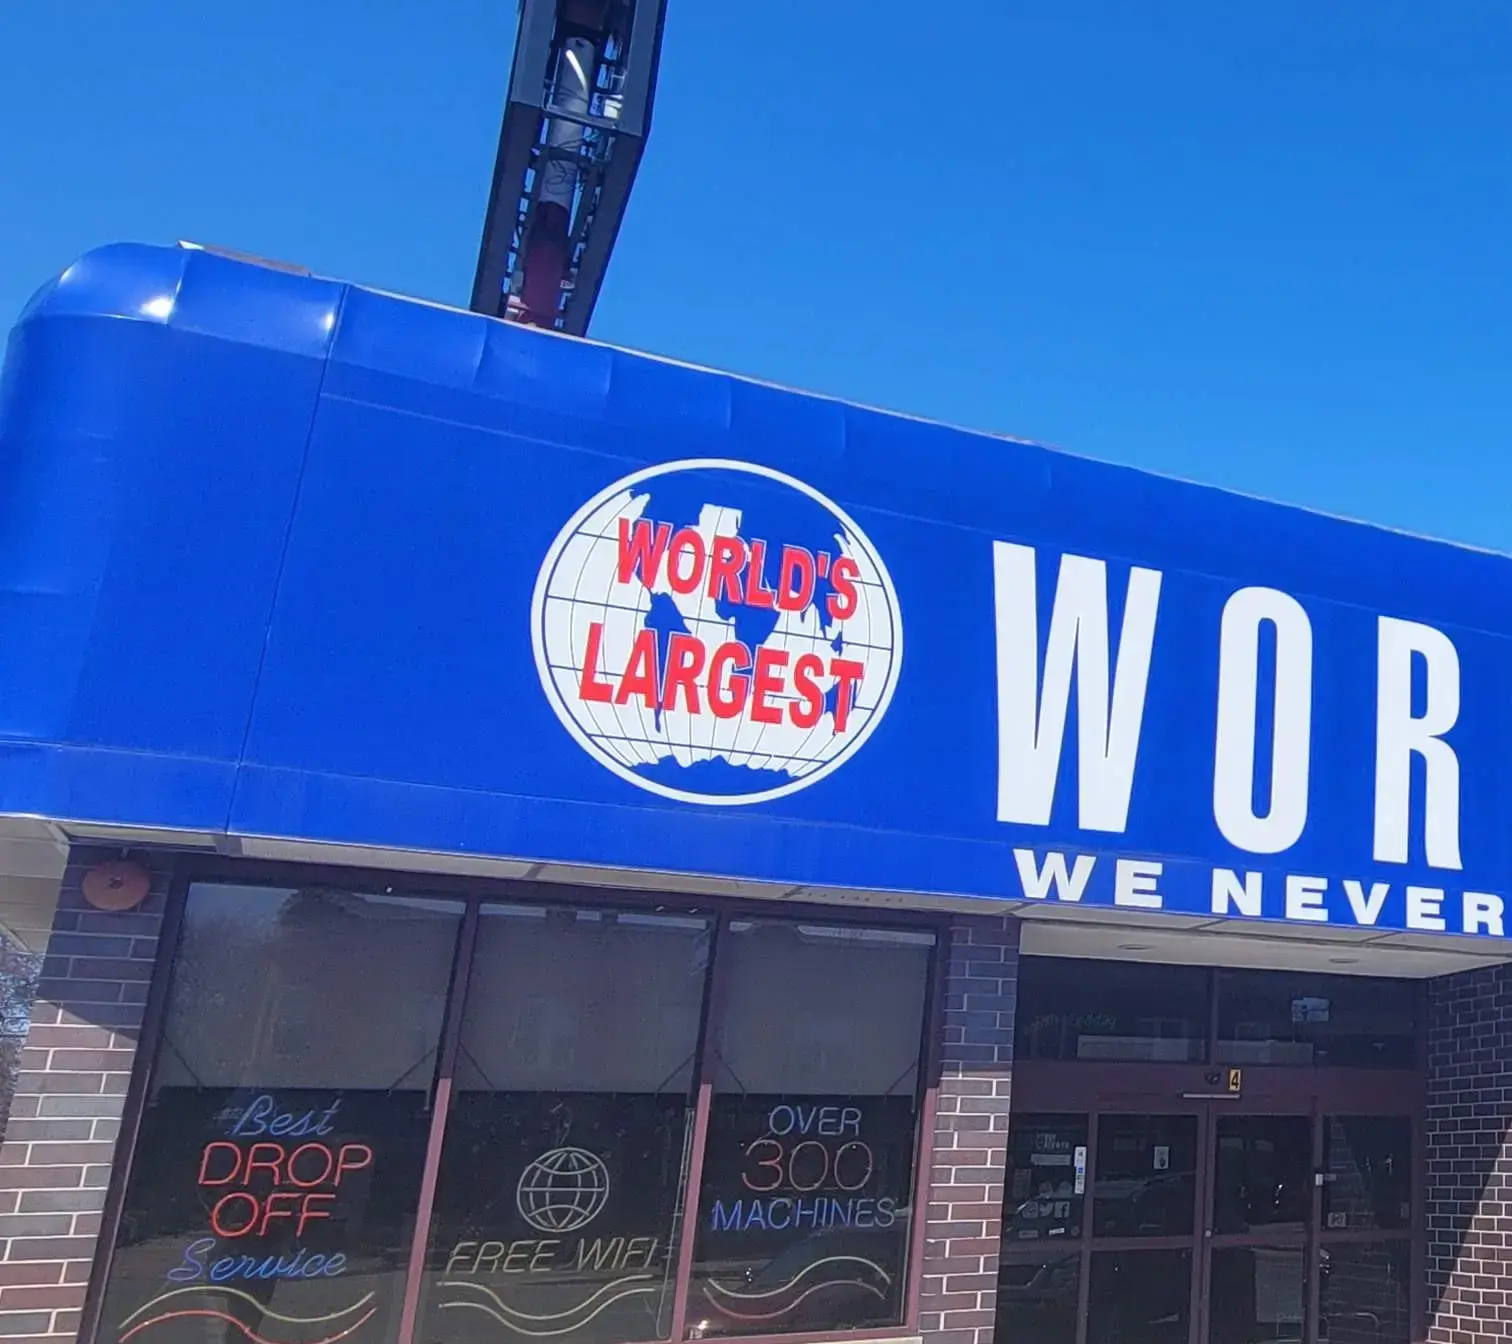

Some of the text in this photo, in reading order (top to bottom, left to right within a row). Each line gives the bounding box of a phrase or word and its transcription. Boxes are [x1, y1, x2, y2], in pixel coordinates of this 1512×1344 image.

[616, 517, 862, 620] WORLD'S
[578, 622, 864, 734] LARGEST
[1013, 848, 1163, 908] WE
[1211, 868, 1504, 937] NEVER
[1231, 1071, 1240, 1089] 4
[225, 1095, 341, 1136] Best
[768, 1105, 862, 1137] OVER
[198, 1142, 373, 1187] DROP
[741, 1139, 873, 1191] 300
[212, 1192, 336, 1238] OFF
[711, 1197, 896, 1231] MACHINES
[167, 1238, 346, 1281] Service
[445, 1237, 658, 1274] FREE WIFI
